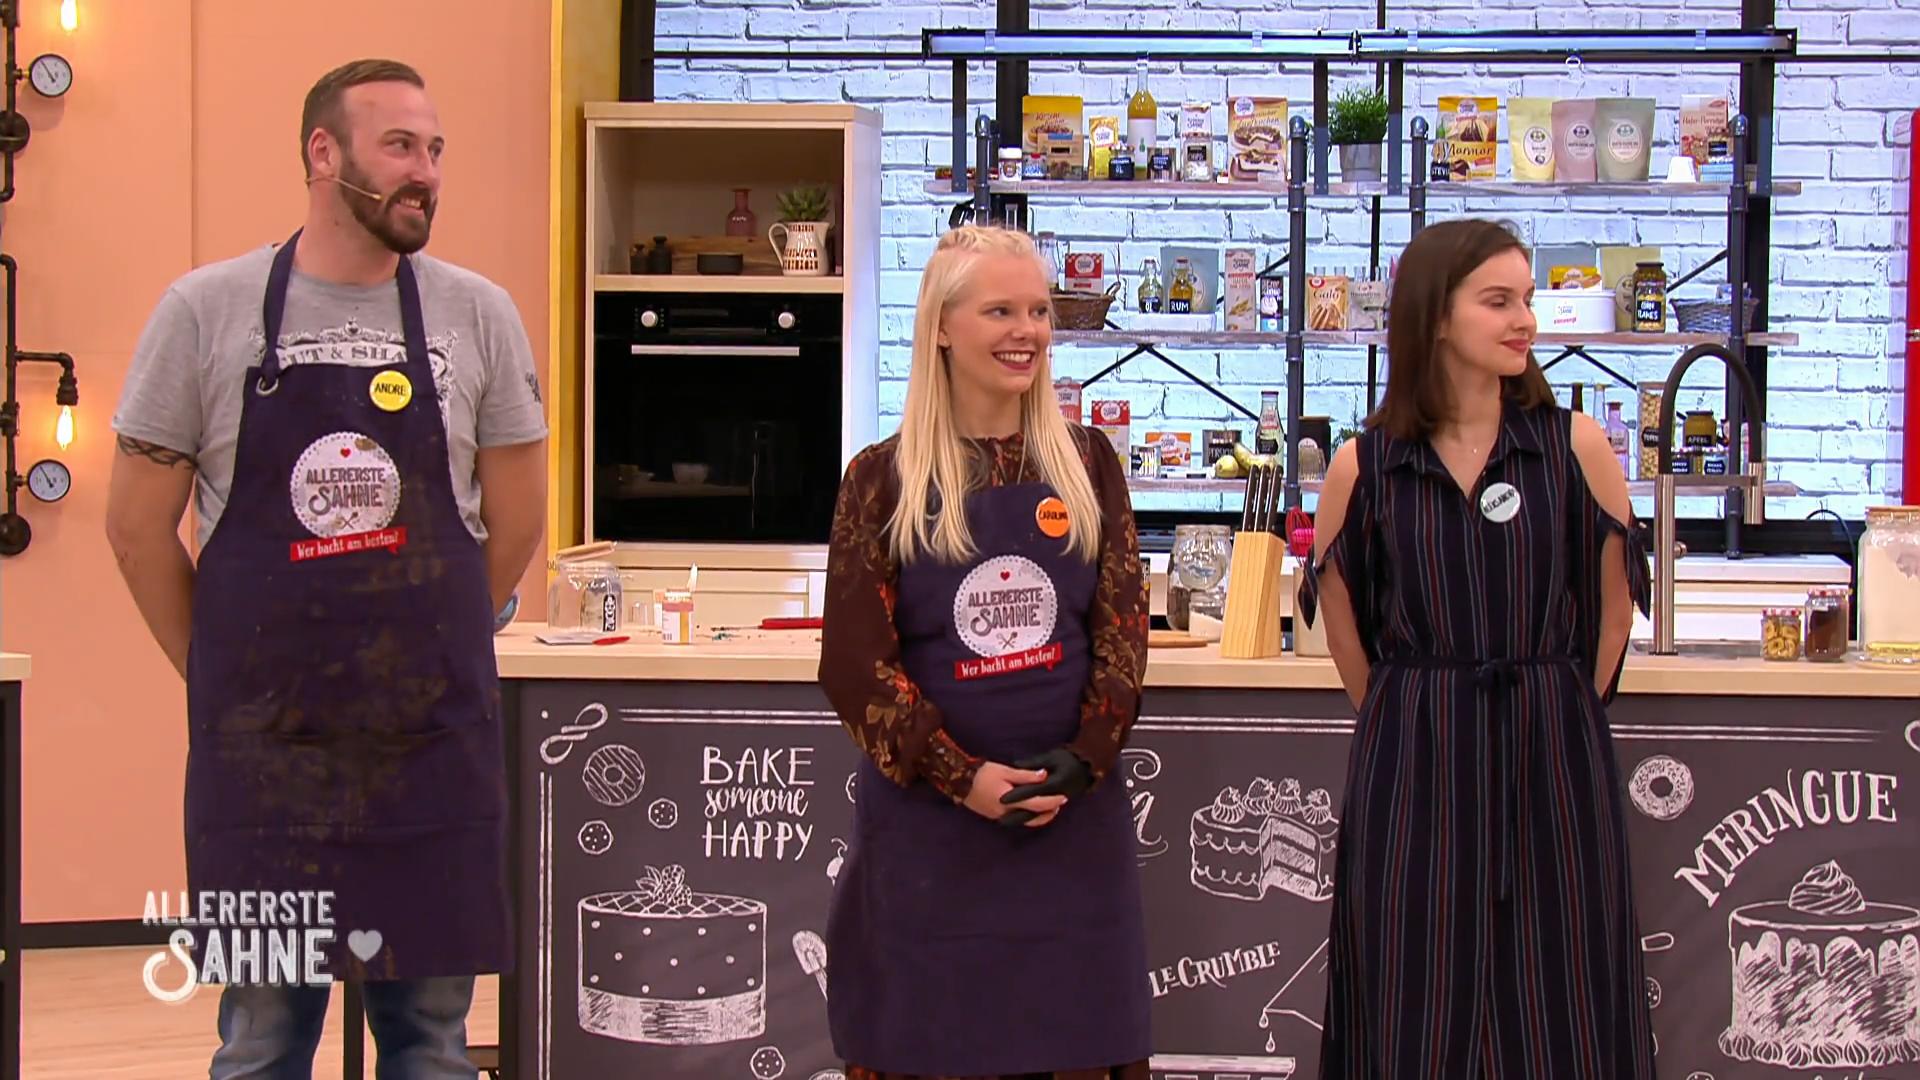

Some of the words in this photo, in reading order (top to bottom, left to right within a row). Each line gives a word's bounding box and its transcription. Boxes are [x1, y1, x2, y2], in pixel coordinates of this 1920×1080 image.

[1170, 302, 1189, 312] RUM
[331, 347, 343, 360] &
[374, 382, 406, 396] ANDRE
[306, 467, 386, 484] ALLERERSTE
[308, 484, 383, 516] SAHNE
[297, 543, 315, 559] Wer
[347, 540, 362, 551] am
[968, 587, 1044, 607] ALLERERSTE
[970, 604, 1041, 636] SAHNE
[961, 662, 979, 677] Wer
[1008, 658, 1022, 669] am
[700, 745, 814, 788] BAKE
[704, 786, 808, 818] someone
[702, 819, 813, 861] HAPPY
[1673, 769, 1898, 908] MERINGUE
